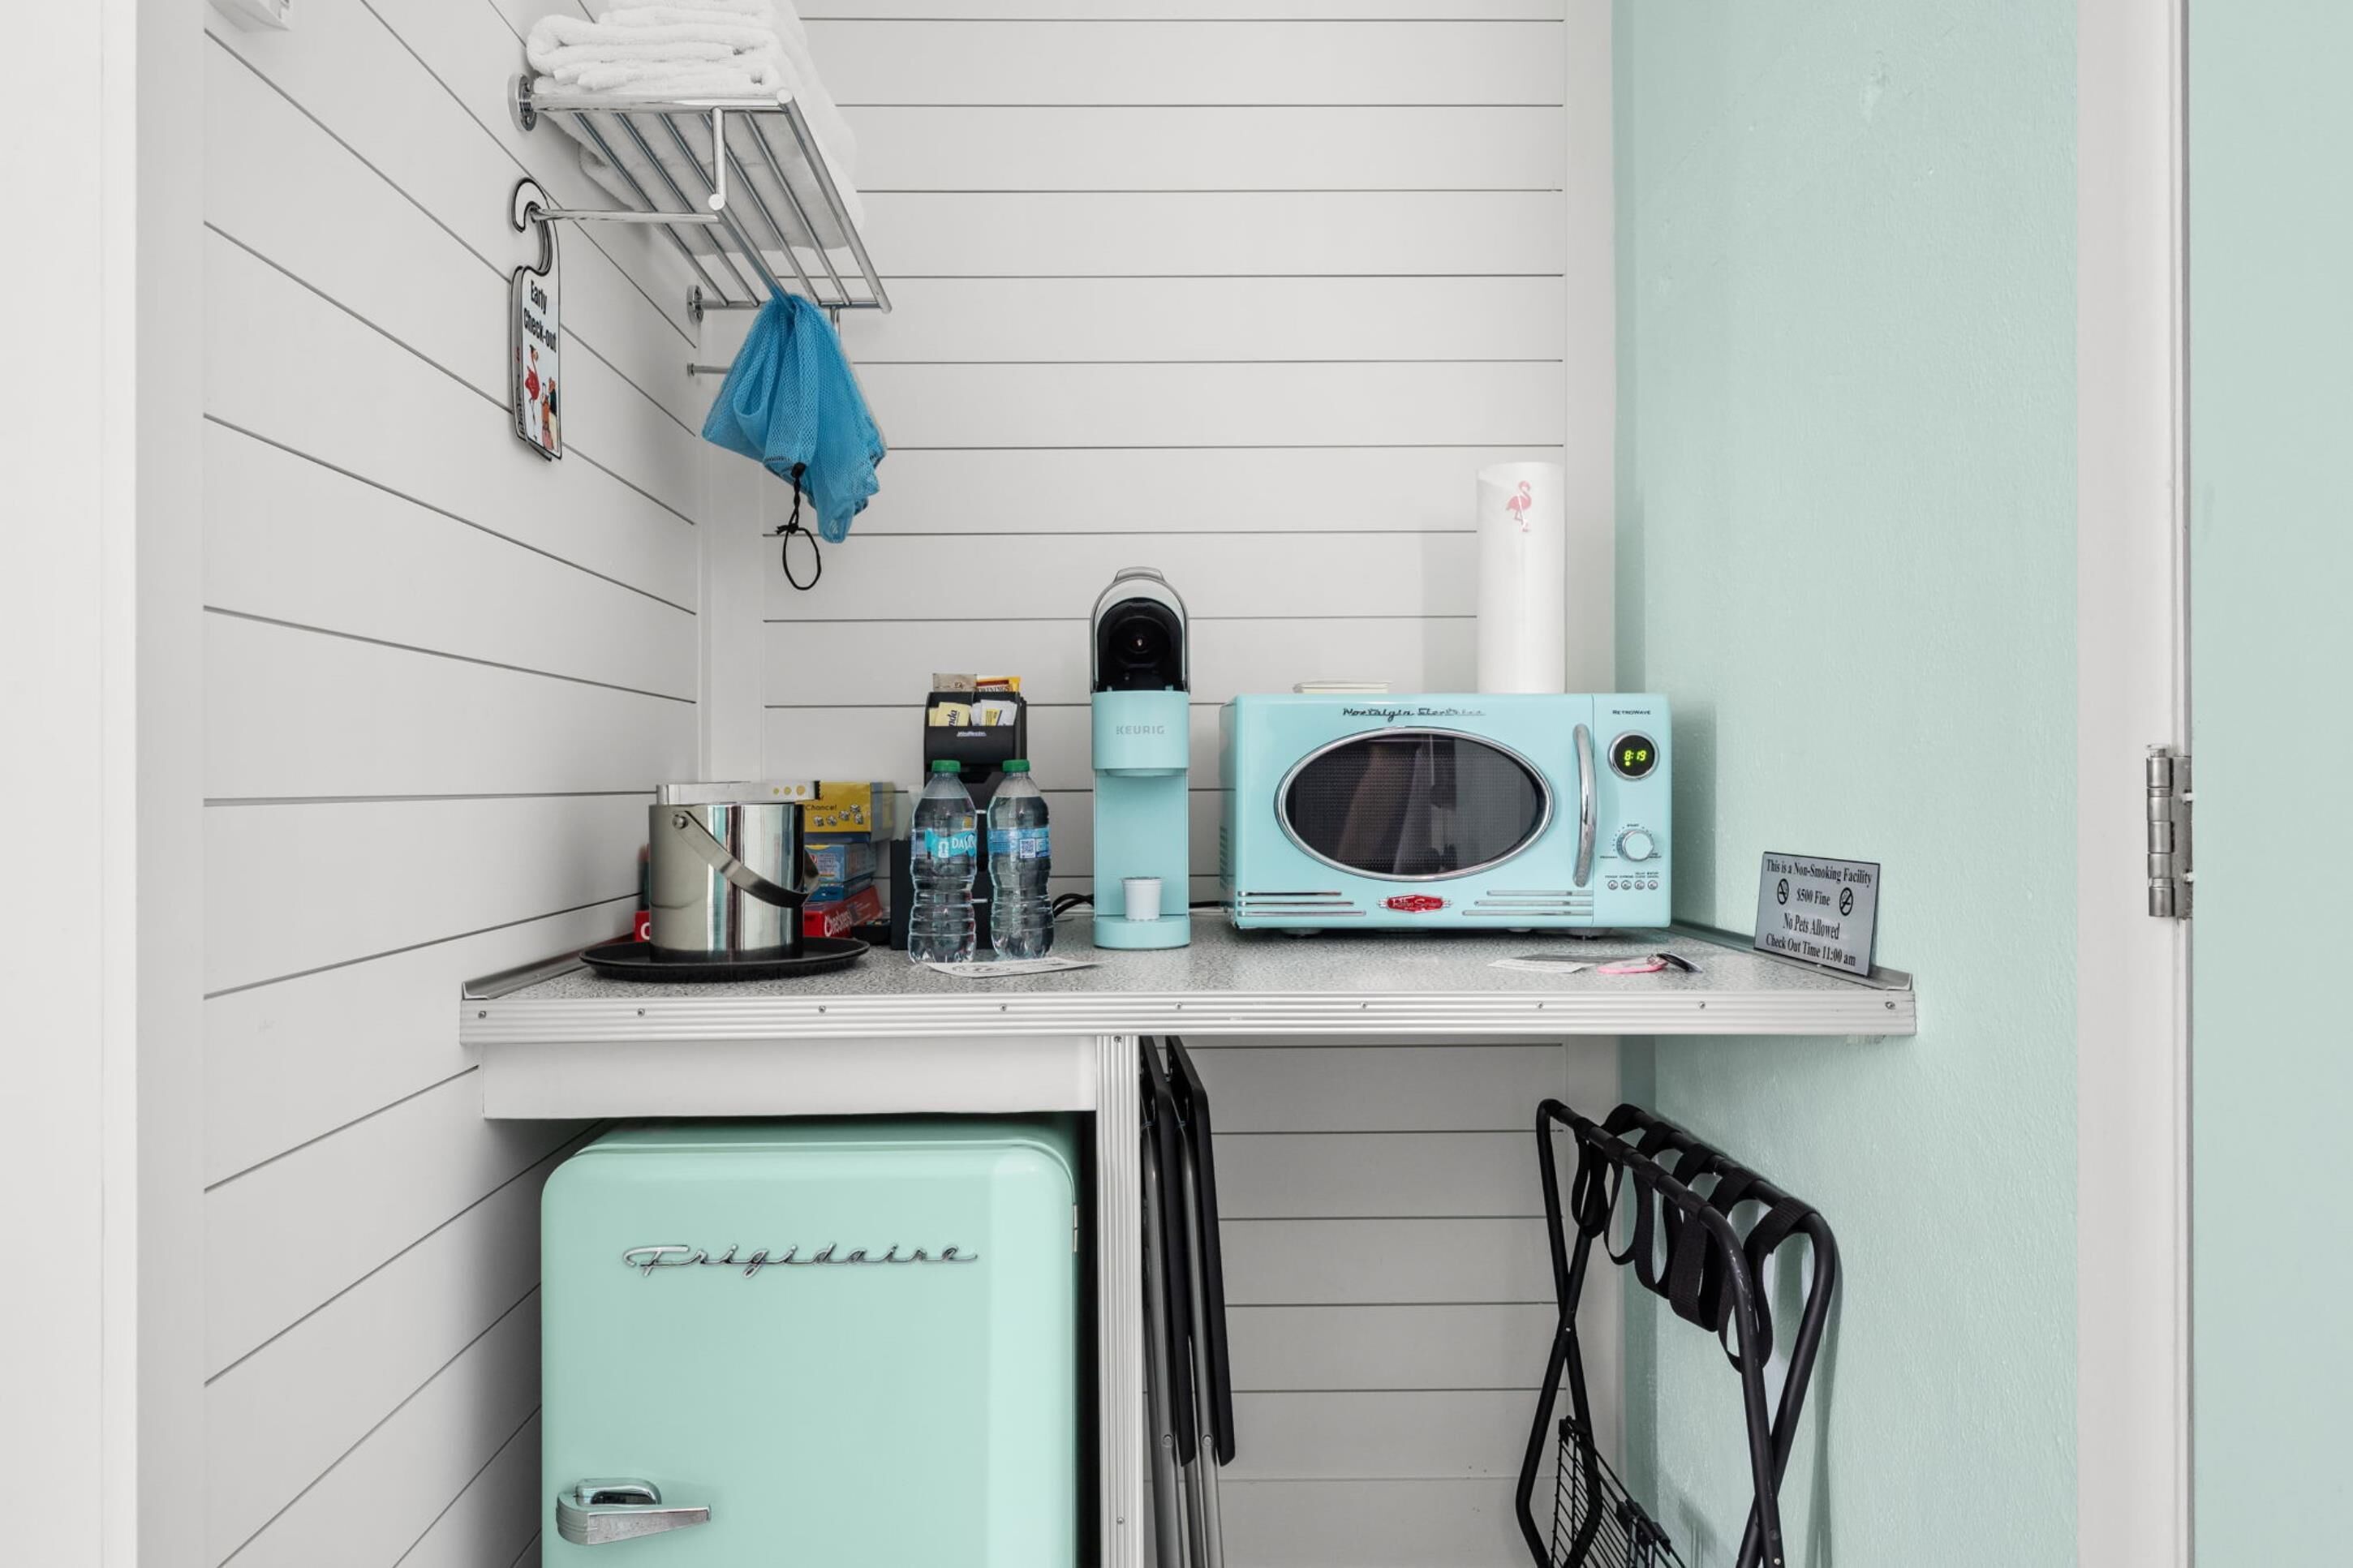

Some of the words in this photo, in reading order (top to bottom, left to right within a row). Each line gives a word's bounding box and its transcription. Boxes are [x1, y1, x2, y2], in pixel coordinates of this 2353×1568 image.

[530, 280, 548, 315] Early
[523, 307, 557, 353] Check-out
[1343, 707, 1415, 722] Nostalgia
[1116, 725, 1166, 735] KEURIG
[1624, 750, 1647, 761] 8:19
[1766, 859, 1780, 873] This
[1781, 861, 1787, 873] is
[1793, 862, 1841, 884] Non-Smoking
[1843, 868, 1872, 887] Facility
[1796, 887, 1813, 903] $500
[1814, 891, 1830, 906] Fine
[1783, 913, 1792, 930] No
[1794, 914, 1809, 934] Pets
[1809, 918, 1840, 940] Allowed
[1766, 933, 1786, 948] Check
[1787, 939, 1801, 953] Out
[1803, 941, 1821, 957] Time
[1822, 946, 1843, 963] 11:00
[1843, 954, 1856, 966] am
[622, 1242, 978, 1278] Frigidaire
